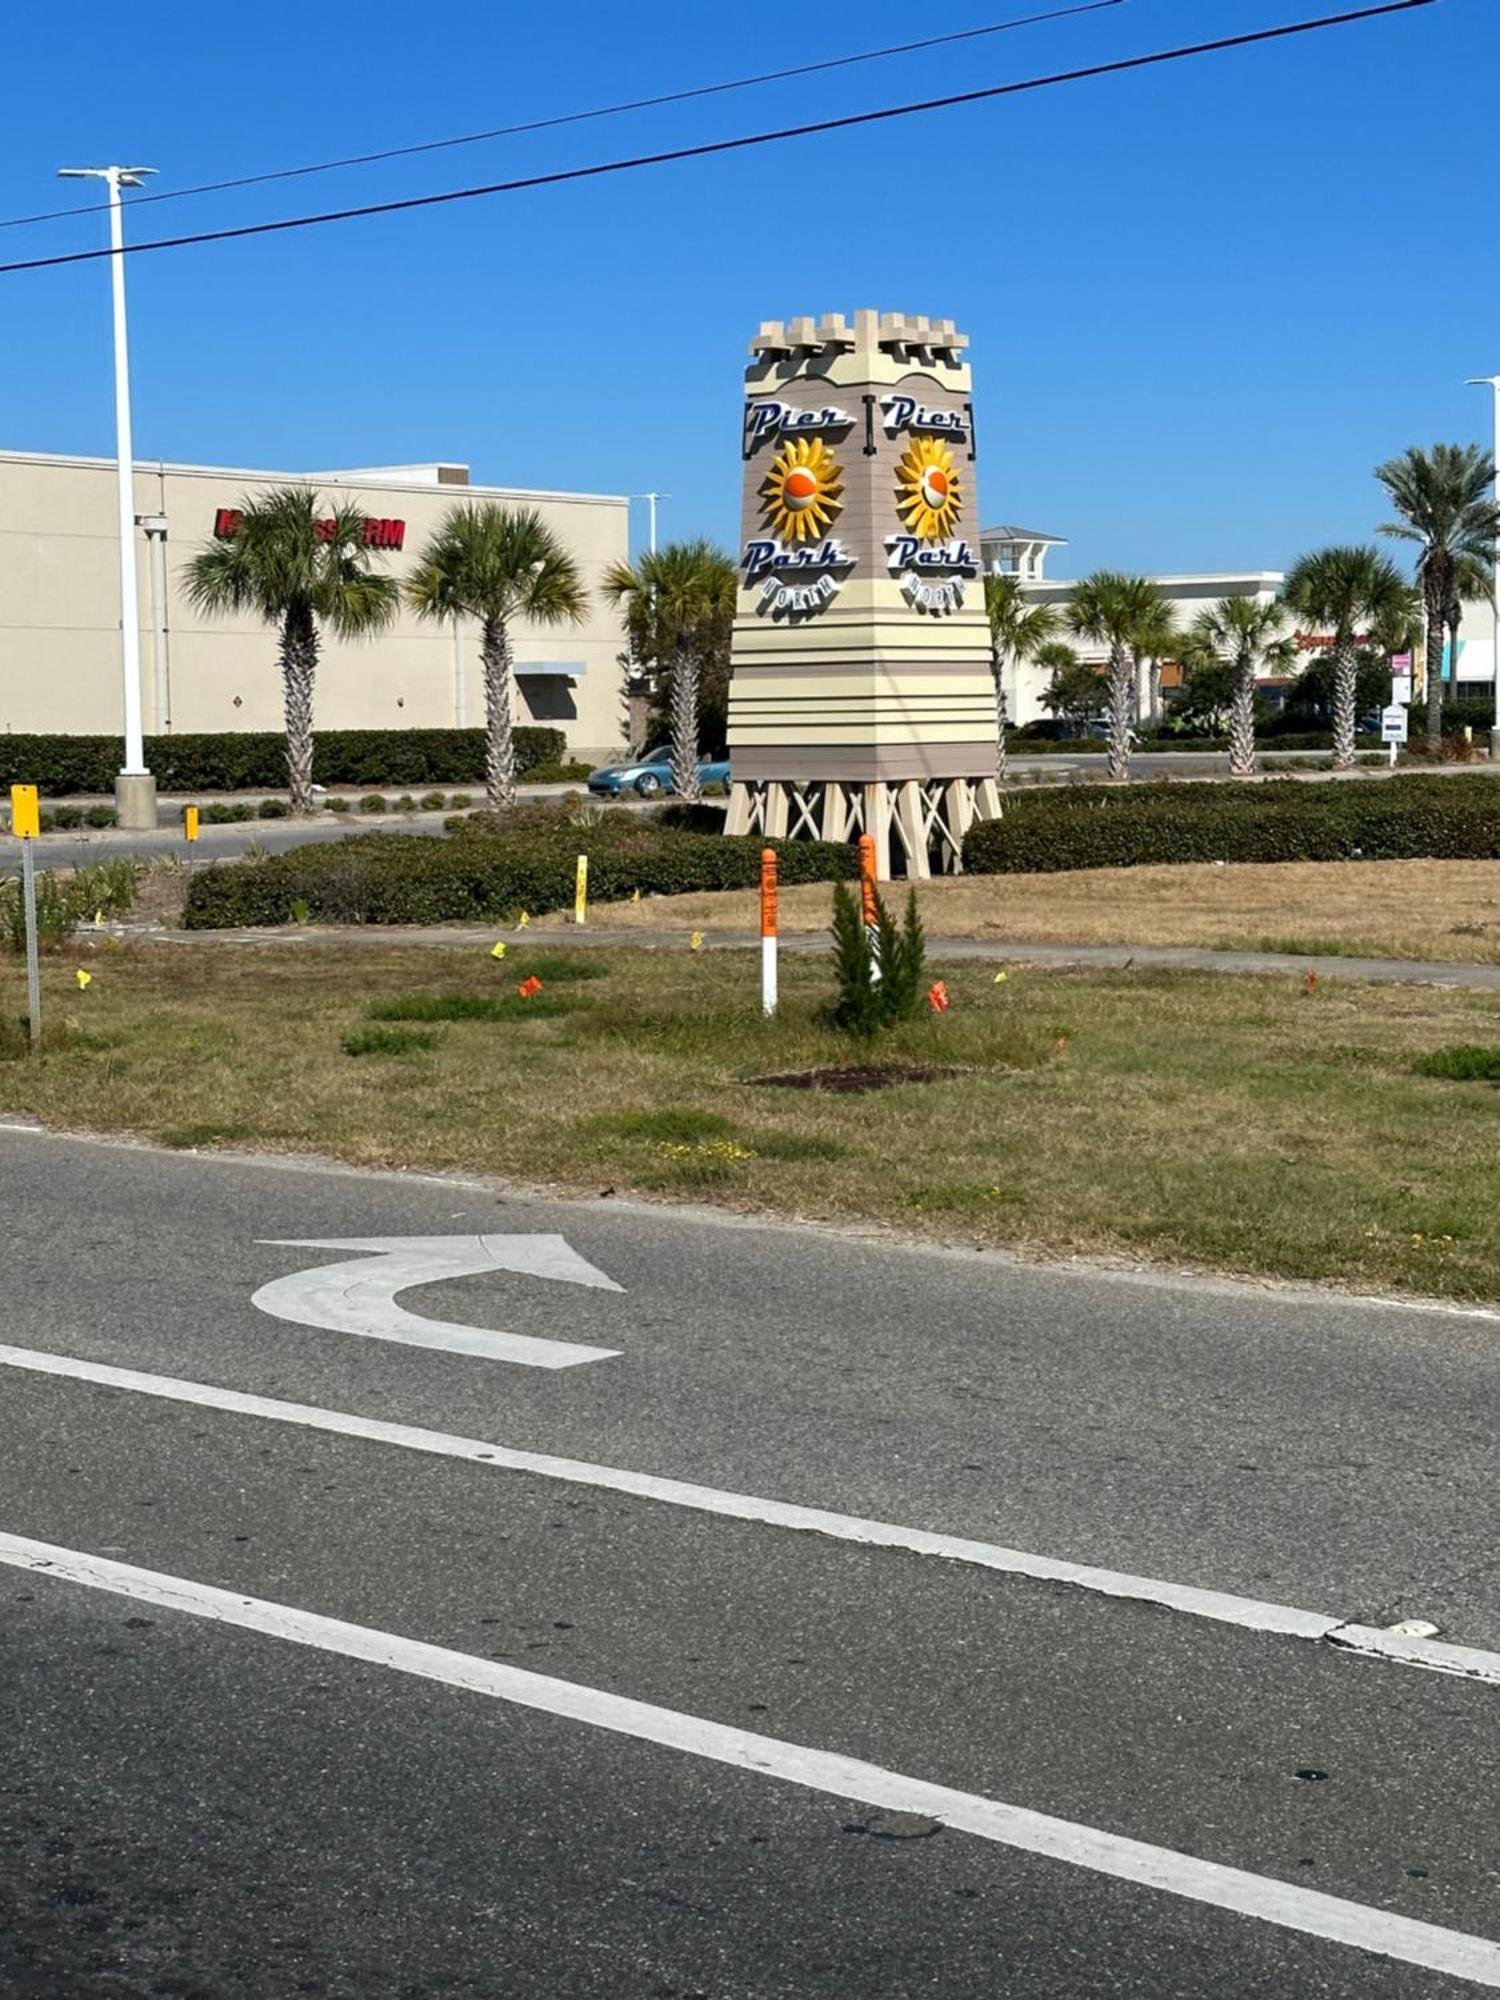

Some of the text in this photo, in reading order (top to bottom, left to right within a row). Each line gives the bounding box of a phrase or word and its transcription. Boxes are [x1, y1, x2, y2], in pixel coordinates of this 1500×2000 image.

[751, 401, 857, 436] Pier
[885, 394, 970, 430] Pier
[746, 539, 858, 572] Park
[888, 535, 980, 567] Park
[758, 575, 837, 610] NORTH
